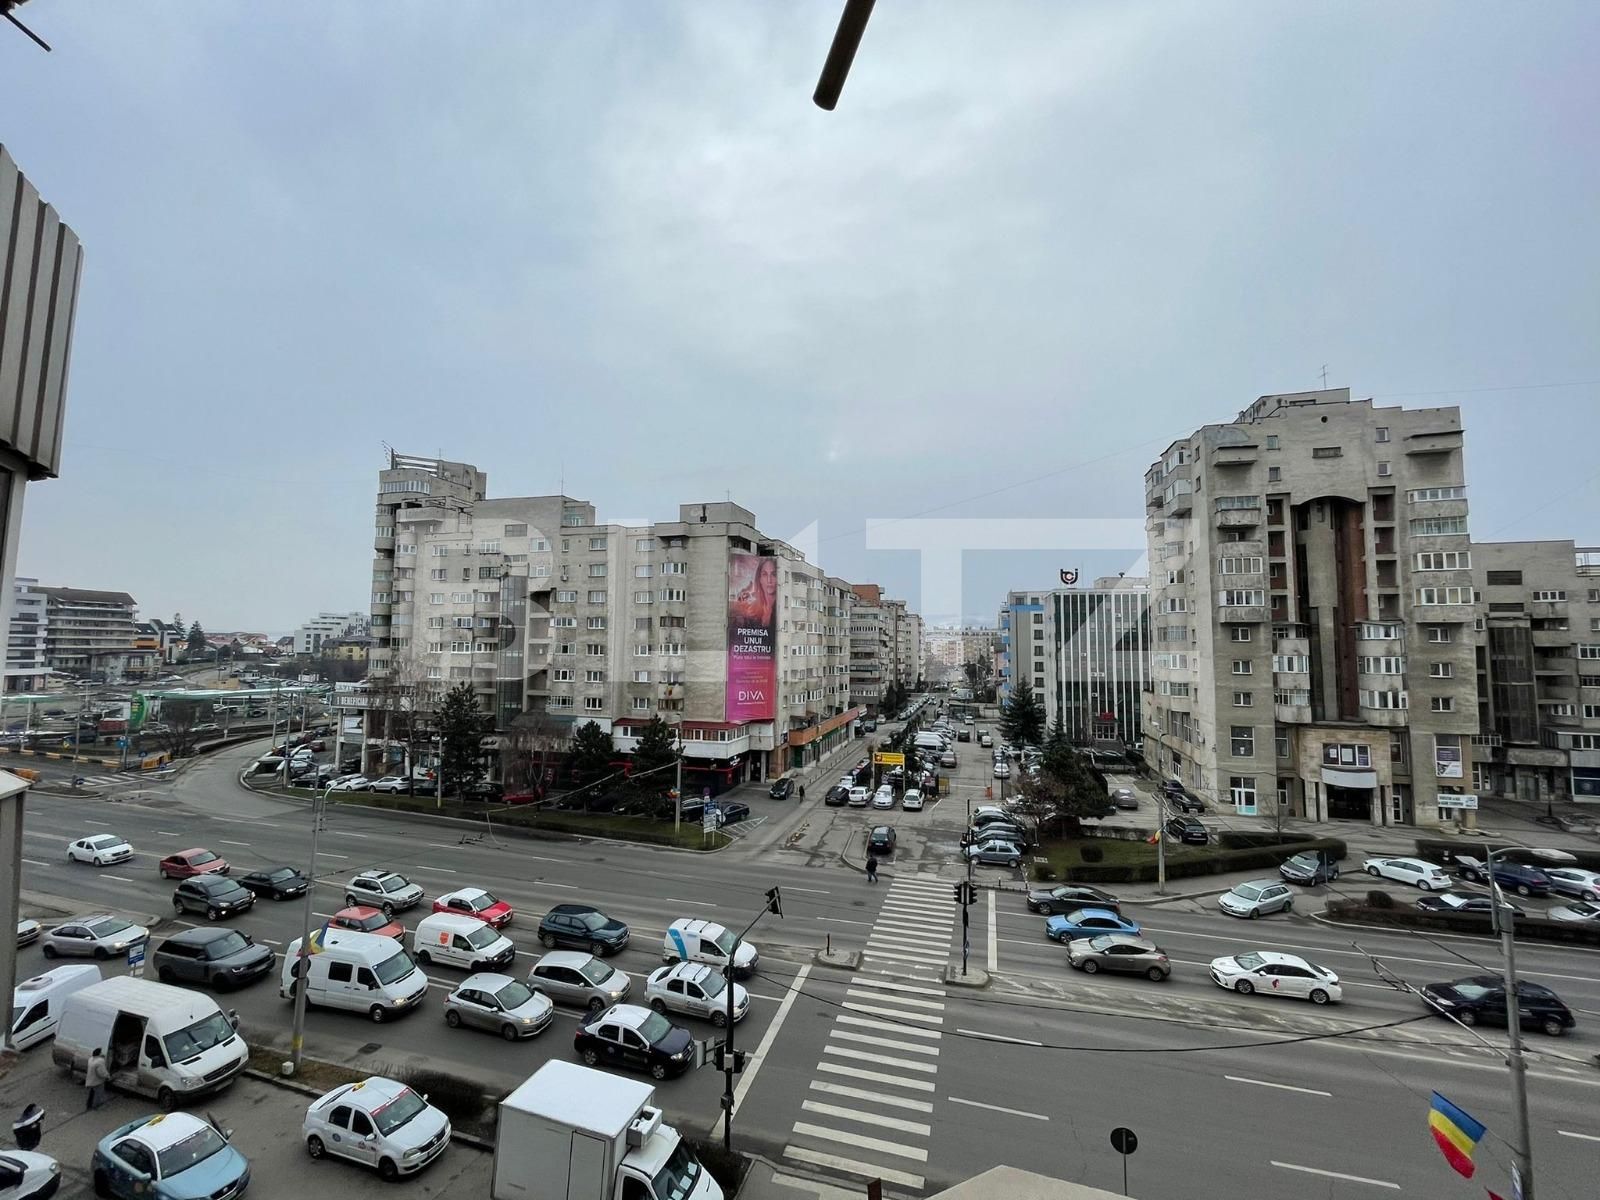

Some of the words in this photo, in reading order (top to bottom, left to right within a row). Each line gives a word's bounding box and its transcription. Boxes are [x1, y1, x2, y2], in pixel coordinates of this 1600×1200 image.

[737, 628, 769, 636] PREMISA
[743, 637, 762, 645] UNUI
[738, 690, 764, 701] DIVA
